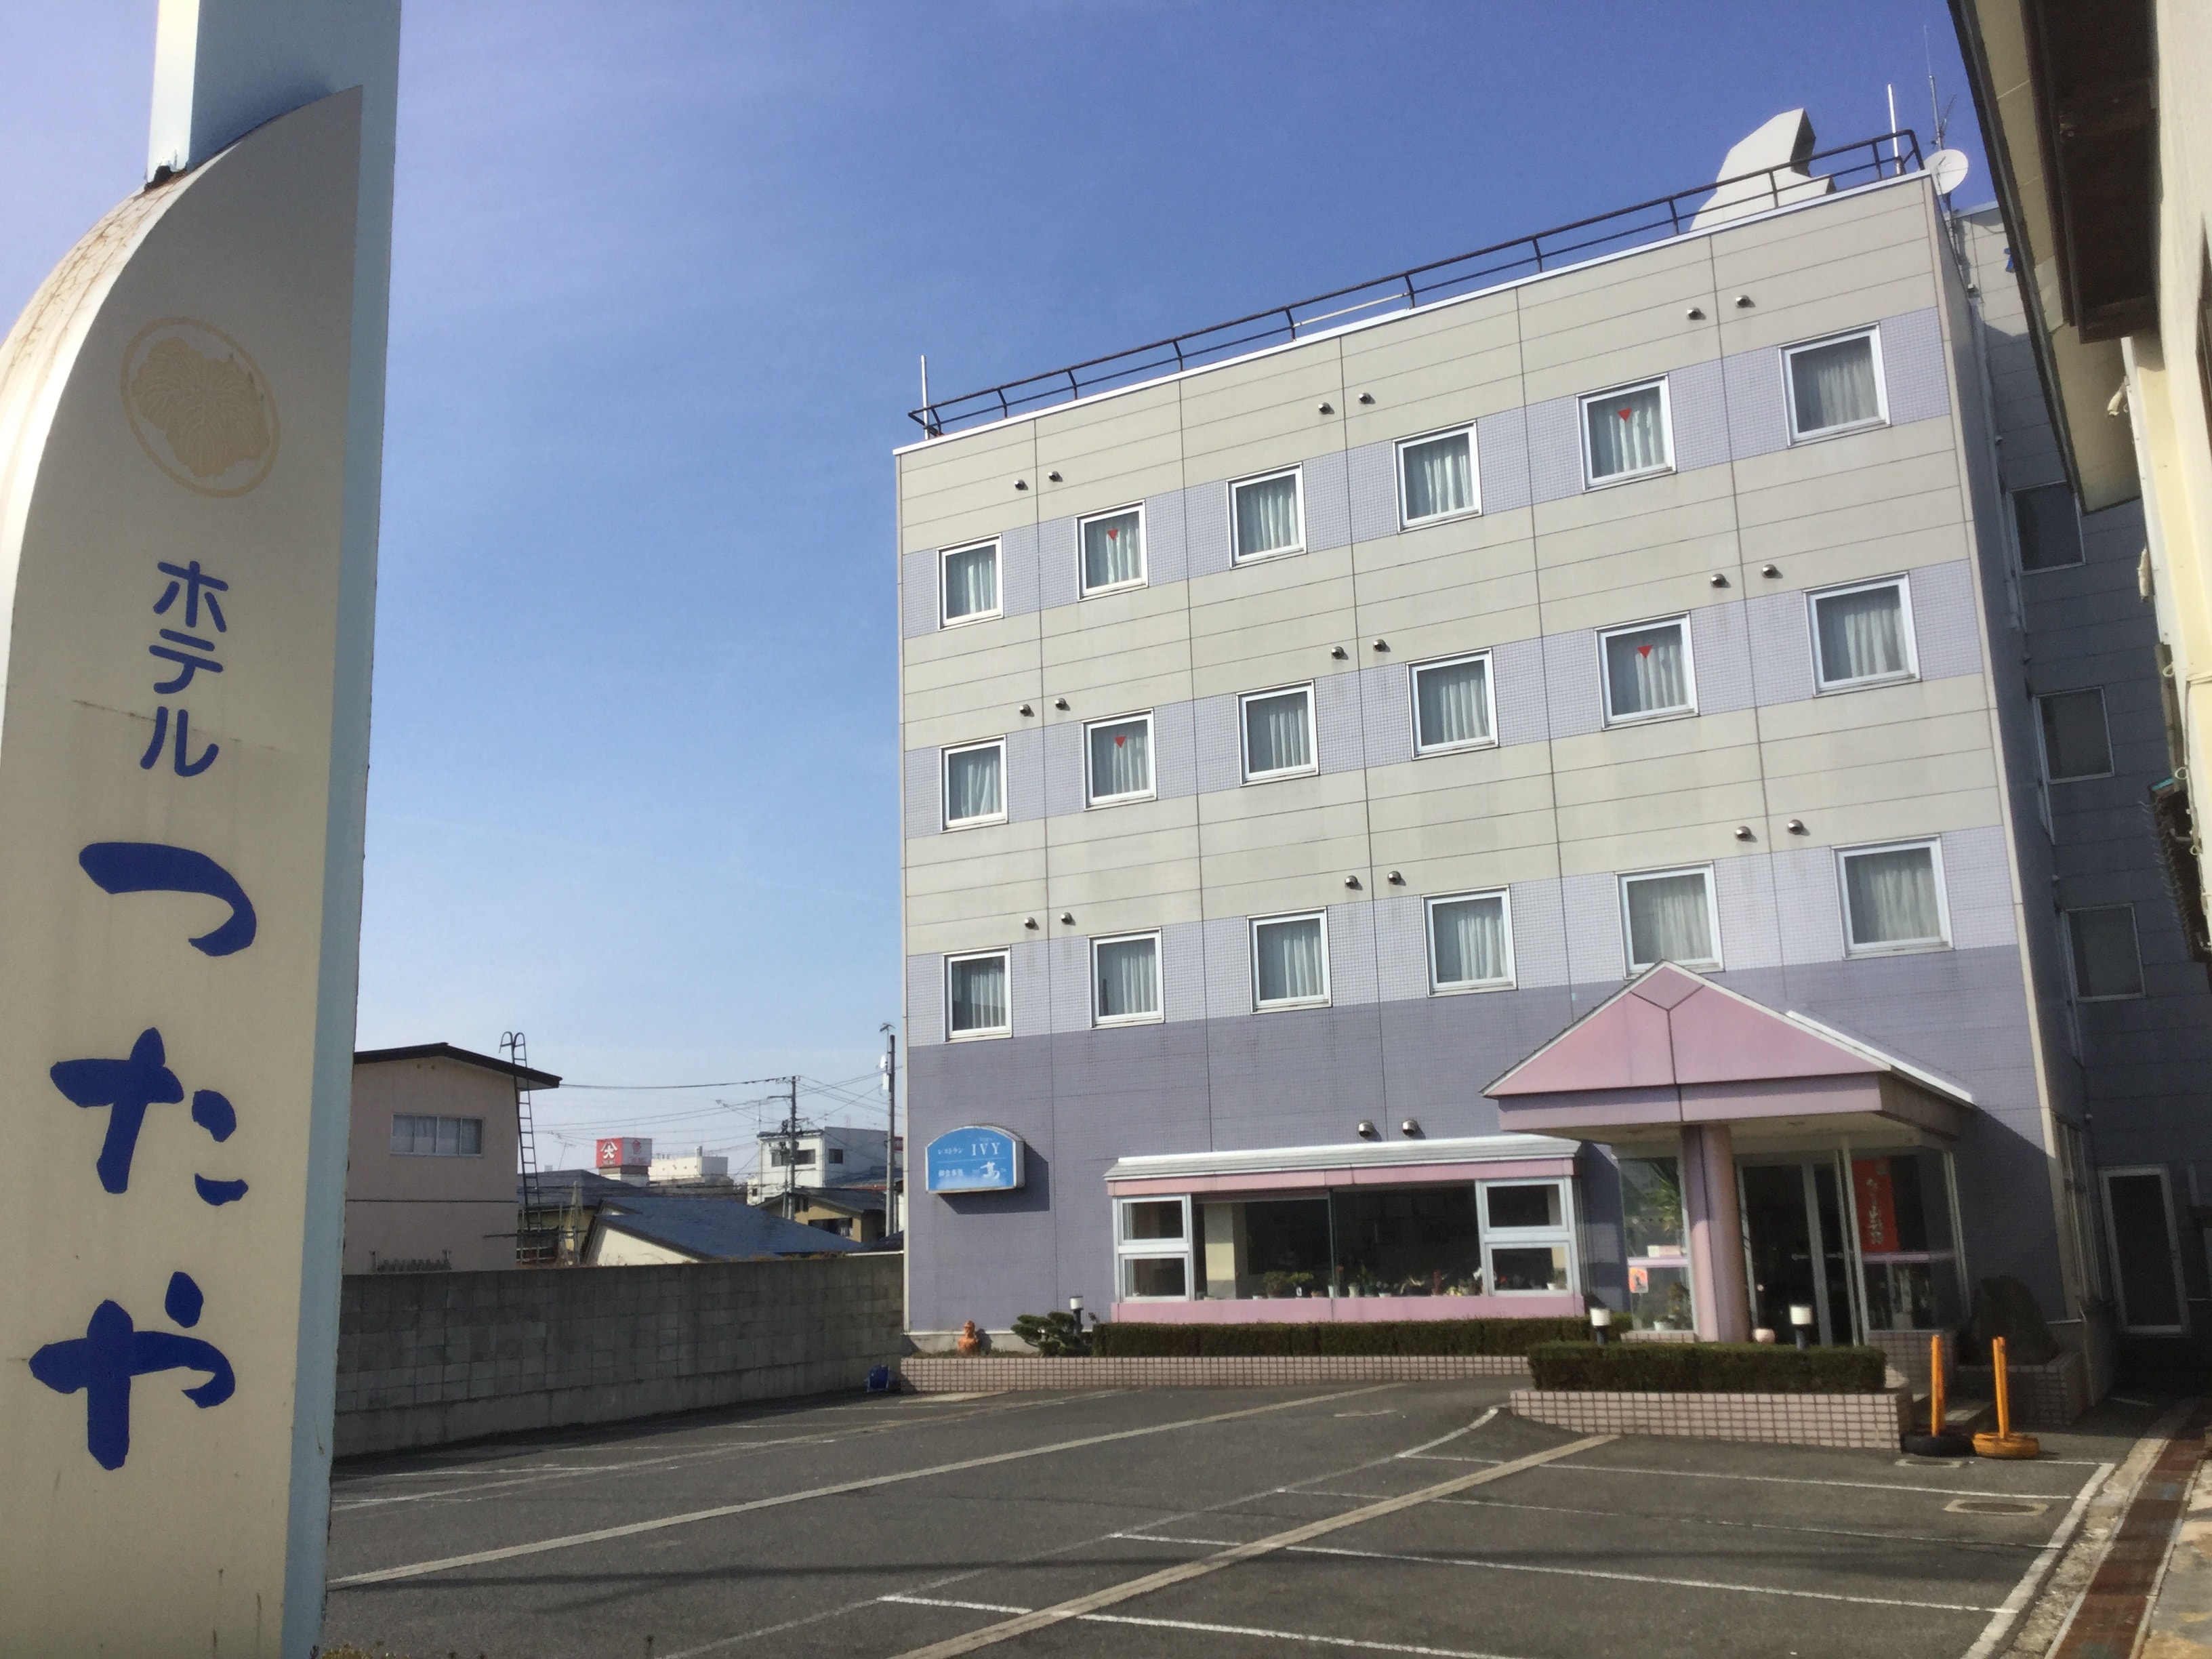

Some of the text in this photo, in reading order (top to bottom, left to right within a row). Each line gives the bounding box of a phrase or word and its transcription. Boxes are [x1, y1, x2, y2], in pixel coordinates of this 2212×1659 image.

[28, 560, 257, 1471] ホテル つたや
[971, 1142, 1000, 1156] IVY
